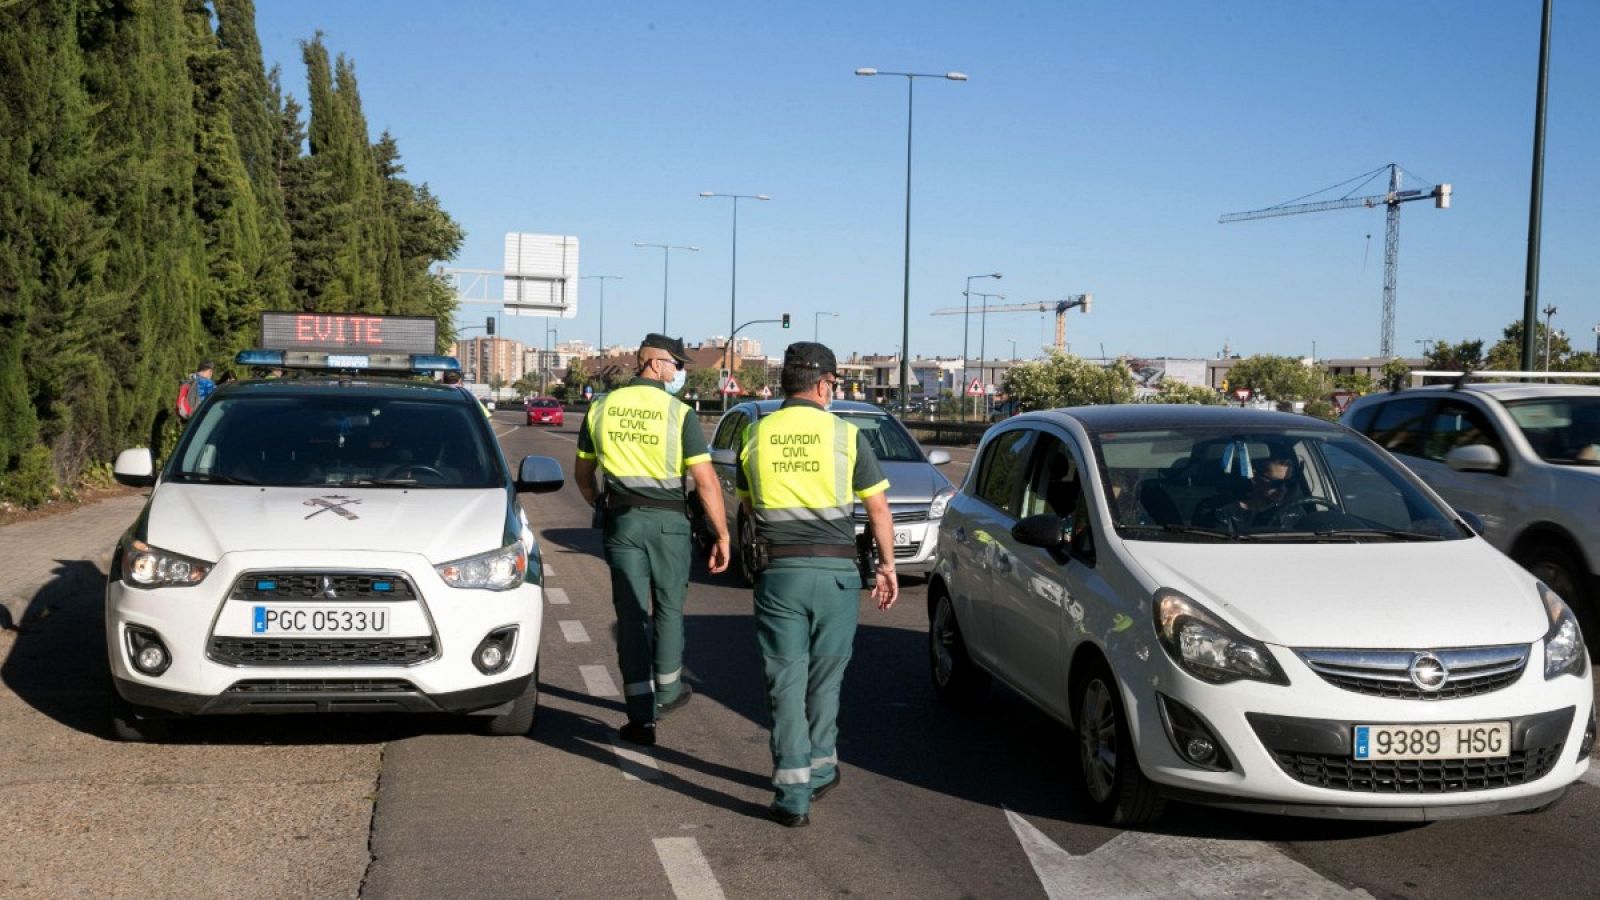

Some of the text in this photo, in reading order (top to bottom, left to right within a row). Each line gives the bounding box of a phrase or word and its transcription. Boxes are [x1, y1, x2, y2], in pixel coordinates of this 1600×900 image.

[297, 315, 384, 344] EVITE
[607, 406, 663, 420] GUARDIA
[619, 419, 647, 430] CIVIL
[770, 433, 821, 445] GUARDIA
[782, 447, 808, 458] CIVIL
[266, 610, 307, 631] PGC
[312, 611, 367, 632] 0533
[371, 611, 385, 632] U
[1376, 729, 1441, 755] 9389
[1456, 728, 1502, 754] HSG
